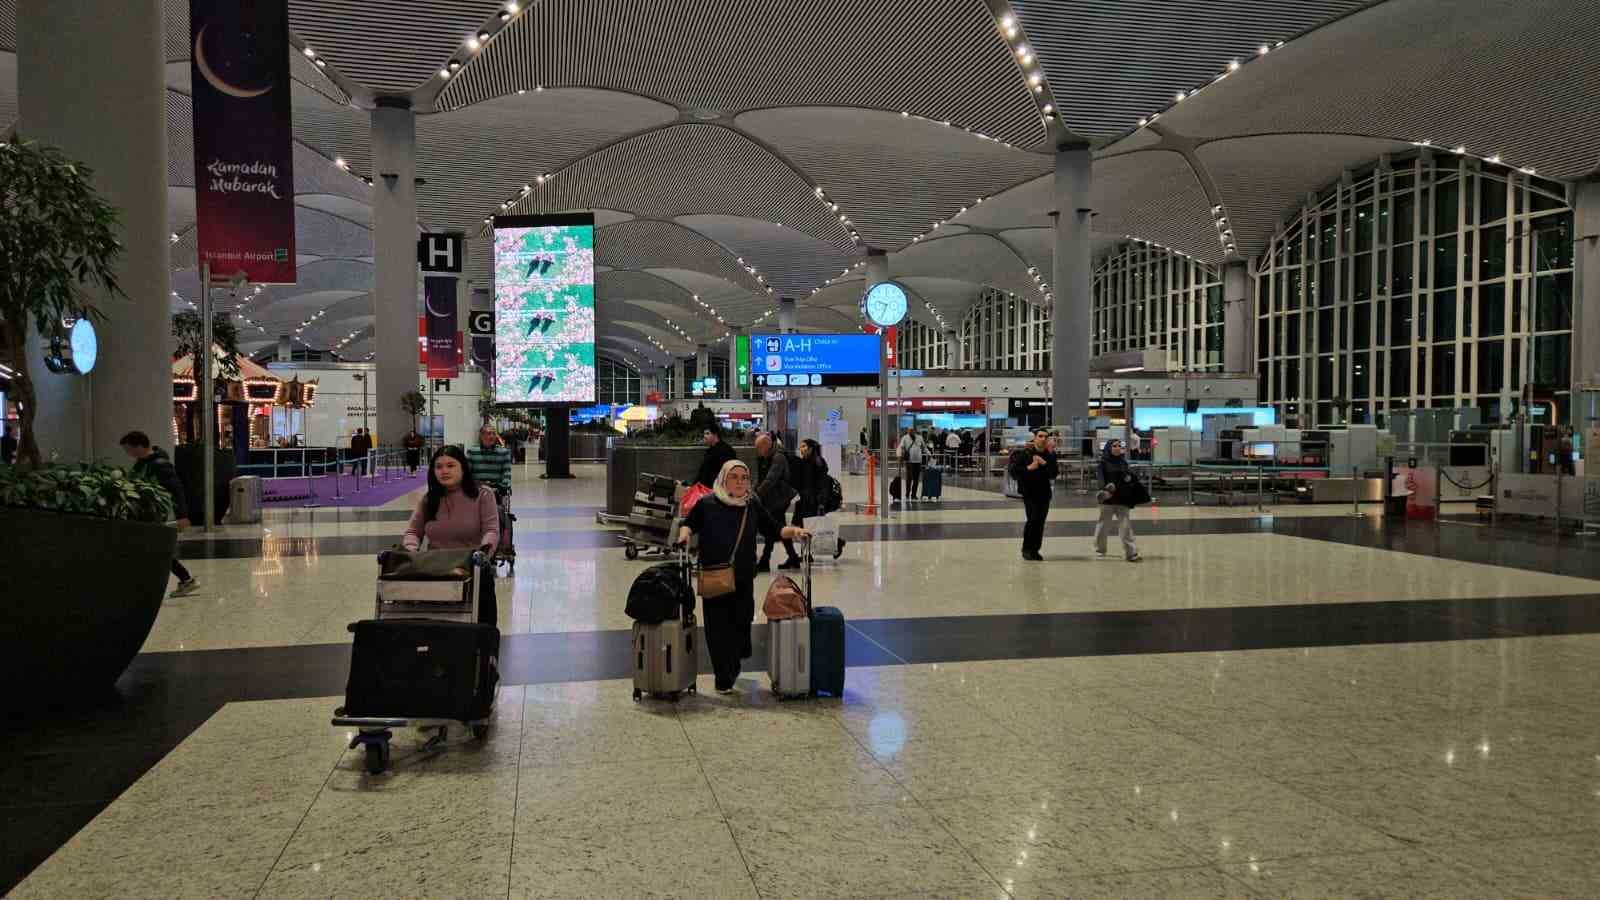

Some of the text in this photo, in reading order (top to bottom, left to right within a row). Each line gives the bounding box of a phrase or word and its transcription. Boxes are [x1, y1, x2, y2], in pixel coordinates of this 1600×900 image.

[207, 160, 279, 177] Ramadan
[209, 177, 281, 199] Mubarak
[243, 251, 274, 262] Airport
[428, 237, 453, 268] H
[474, 313, 491, 332] G
[784, 338, 811, 353] A-H
